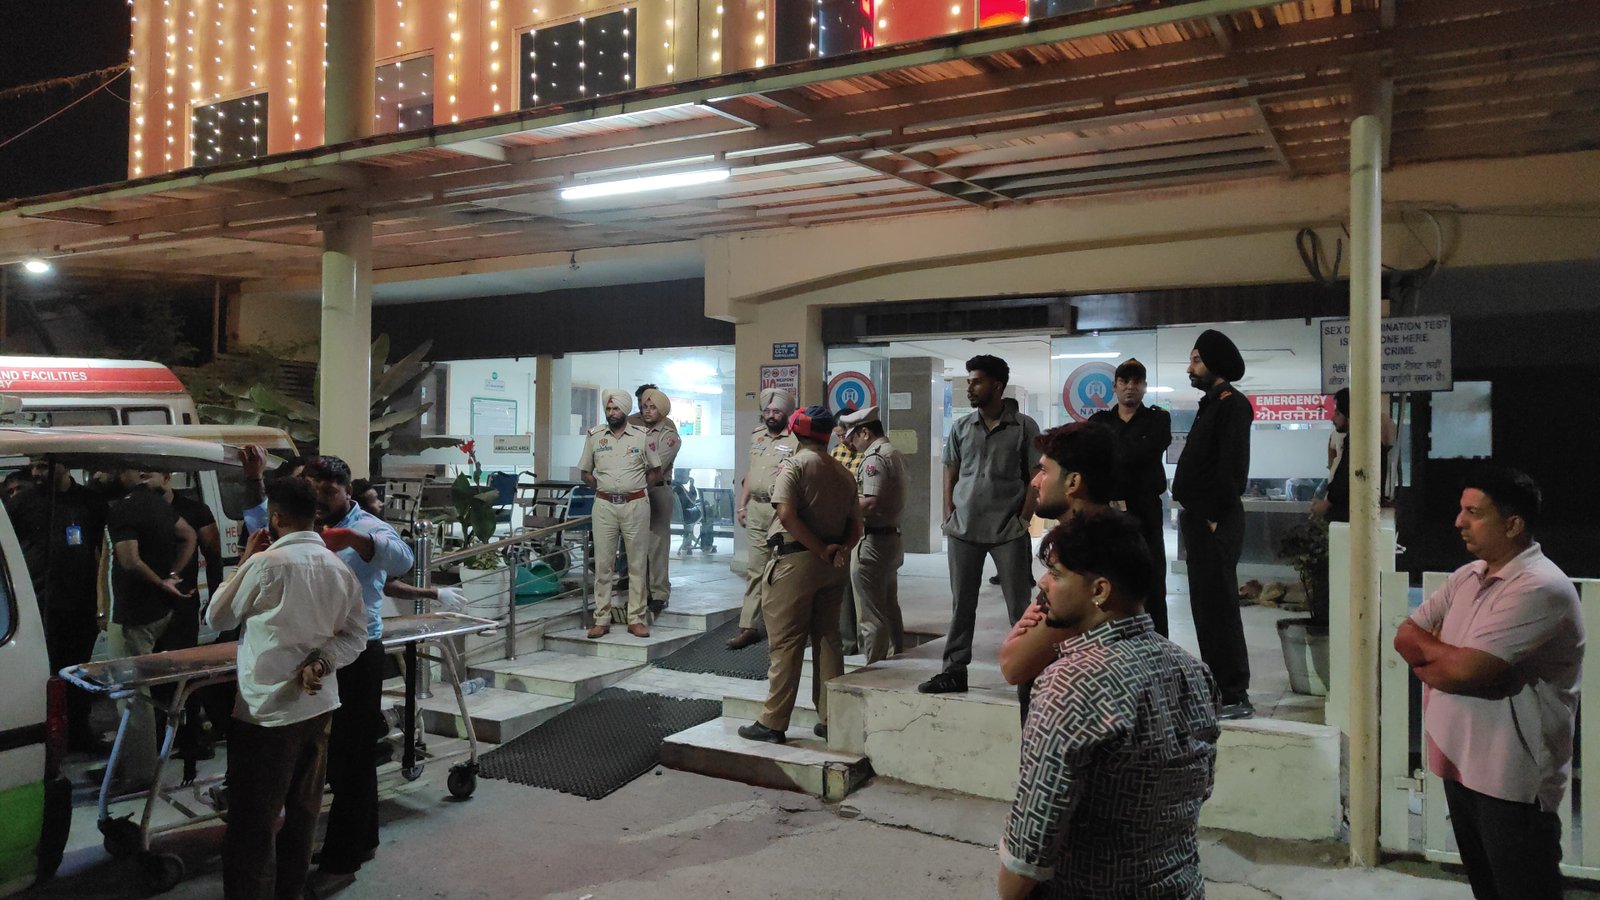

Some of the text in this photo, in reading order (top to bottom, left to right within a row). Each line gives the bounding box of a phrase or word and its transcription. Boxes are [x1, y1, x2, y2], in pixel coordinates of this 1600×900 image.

[1324, 326, 1342, 335] SEX
[1424, 320, 1448, 329] TEST
[1340, 337, 1349, 346] IS
[1402, 333, 1429, 342] HERE
[22, 371, 88, 381] FACILITIES
[1256, 395, 1328, 406] EMERGENCY
